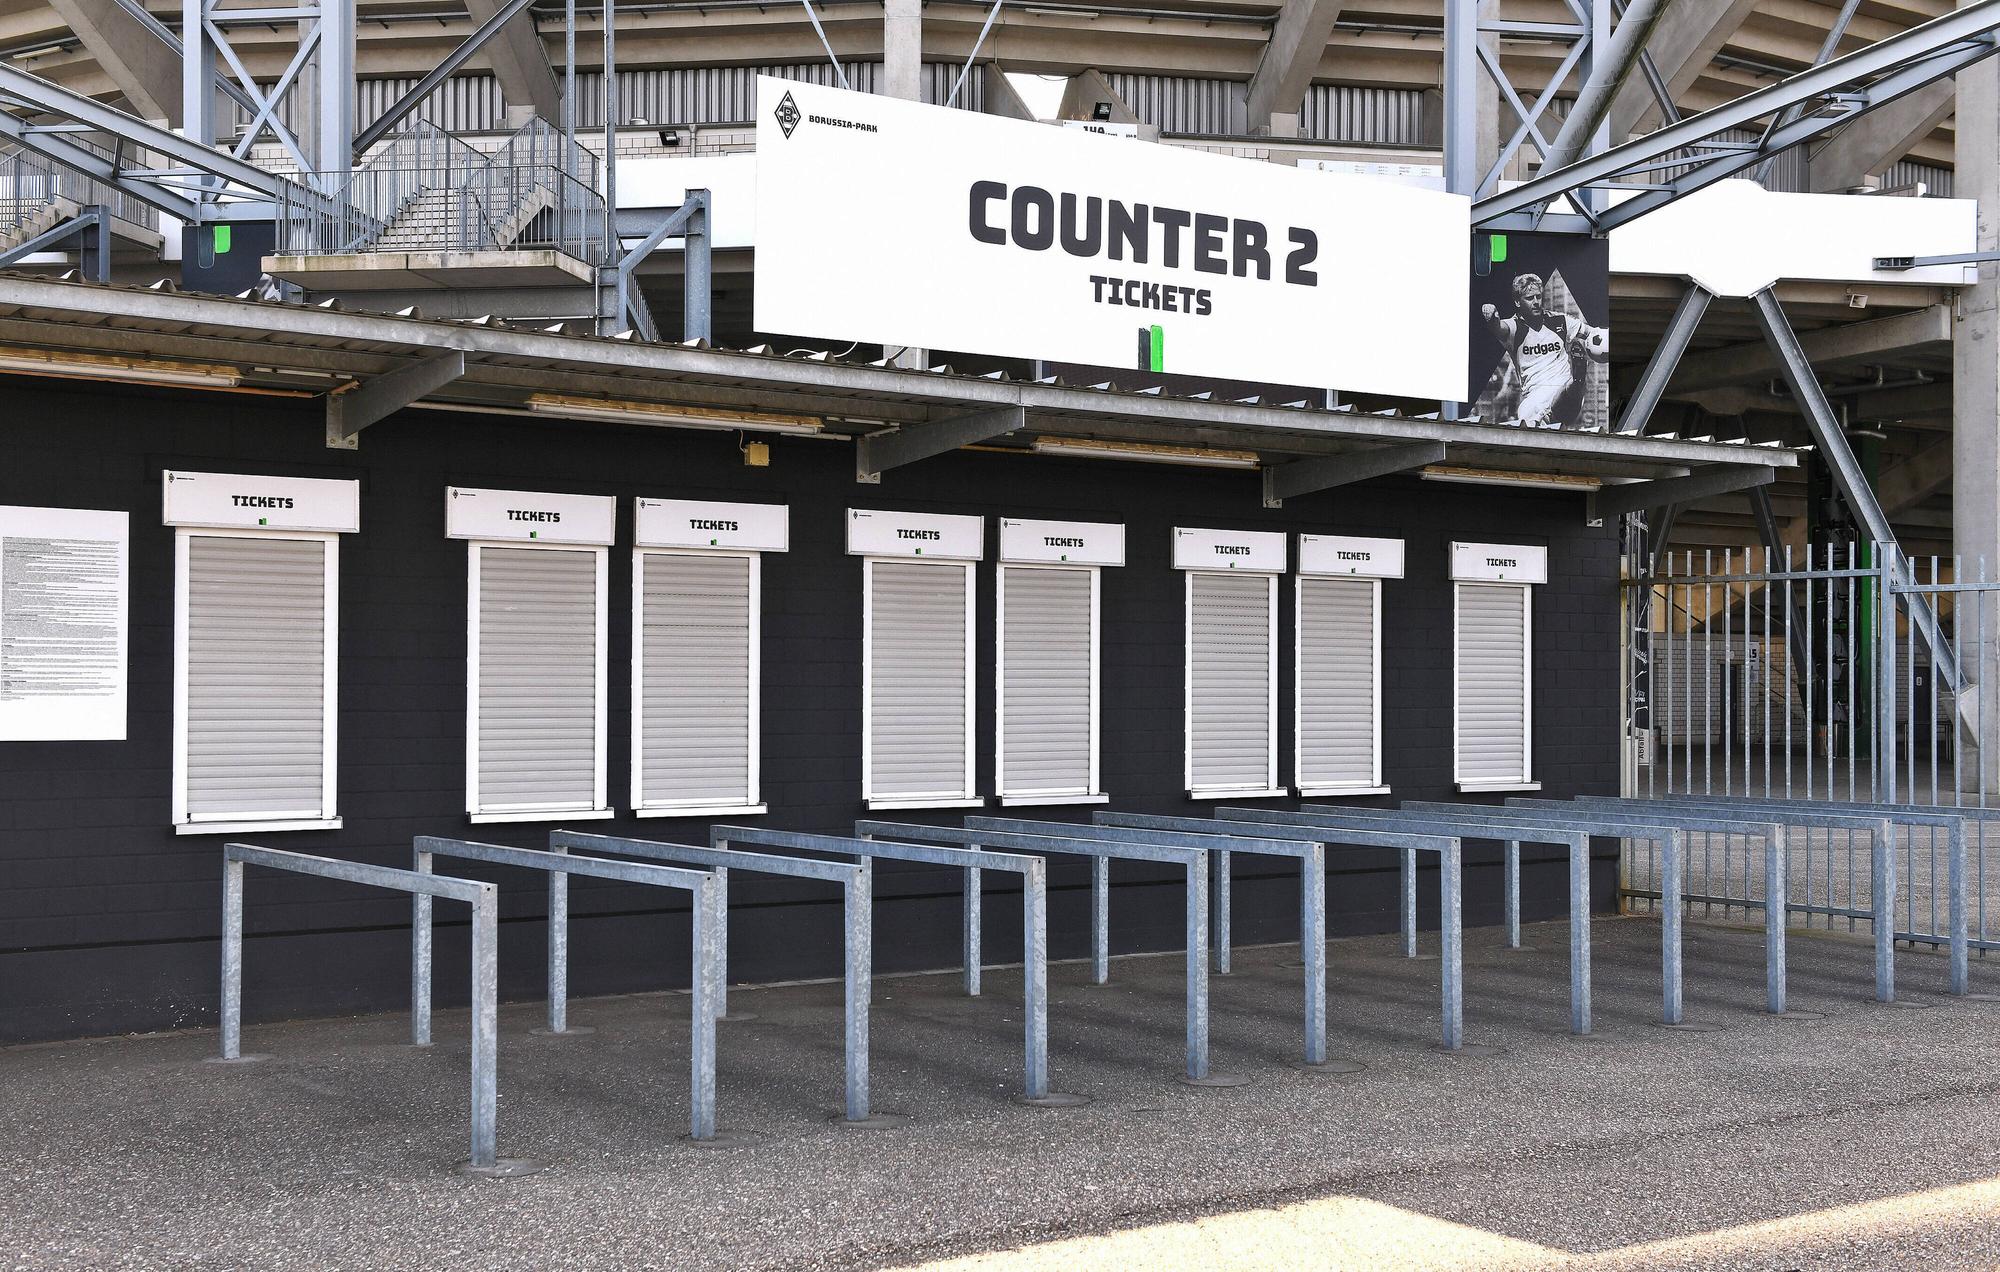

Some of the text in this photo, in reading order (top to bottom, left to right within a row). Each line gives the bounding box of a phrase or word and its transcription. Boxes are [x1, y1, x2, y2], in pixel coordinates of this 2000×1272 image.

[809, 115, 878, 133] BORUSSIA-PARK
[969, 180, 1318, 286] COUNTER 2
[1090, 274, 1212, 316] TICKETS
[1522, 340, 1561, 355] erdgas
[232, 495, 294, 509] TICKETS
[507, 509, 561, 523] TICKETS
[689, 519, 738, 531] TICKETS
[897, 529, 940, 541] TICKETS
[1044, 536, 1084, 548] TICKETS
[1214, 545, 1251, 555] TICKETS
[1337, 551, 1371, 561] TICKETS
[1486, 558, 1517, 567] TICKETS
